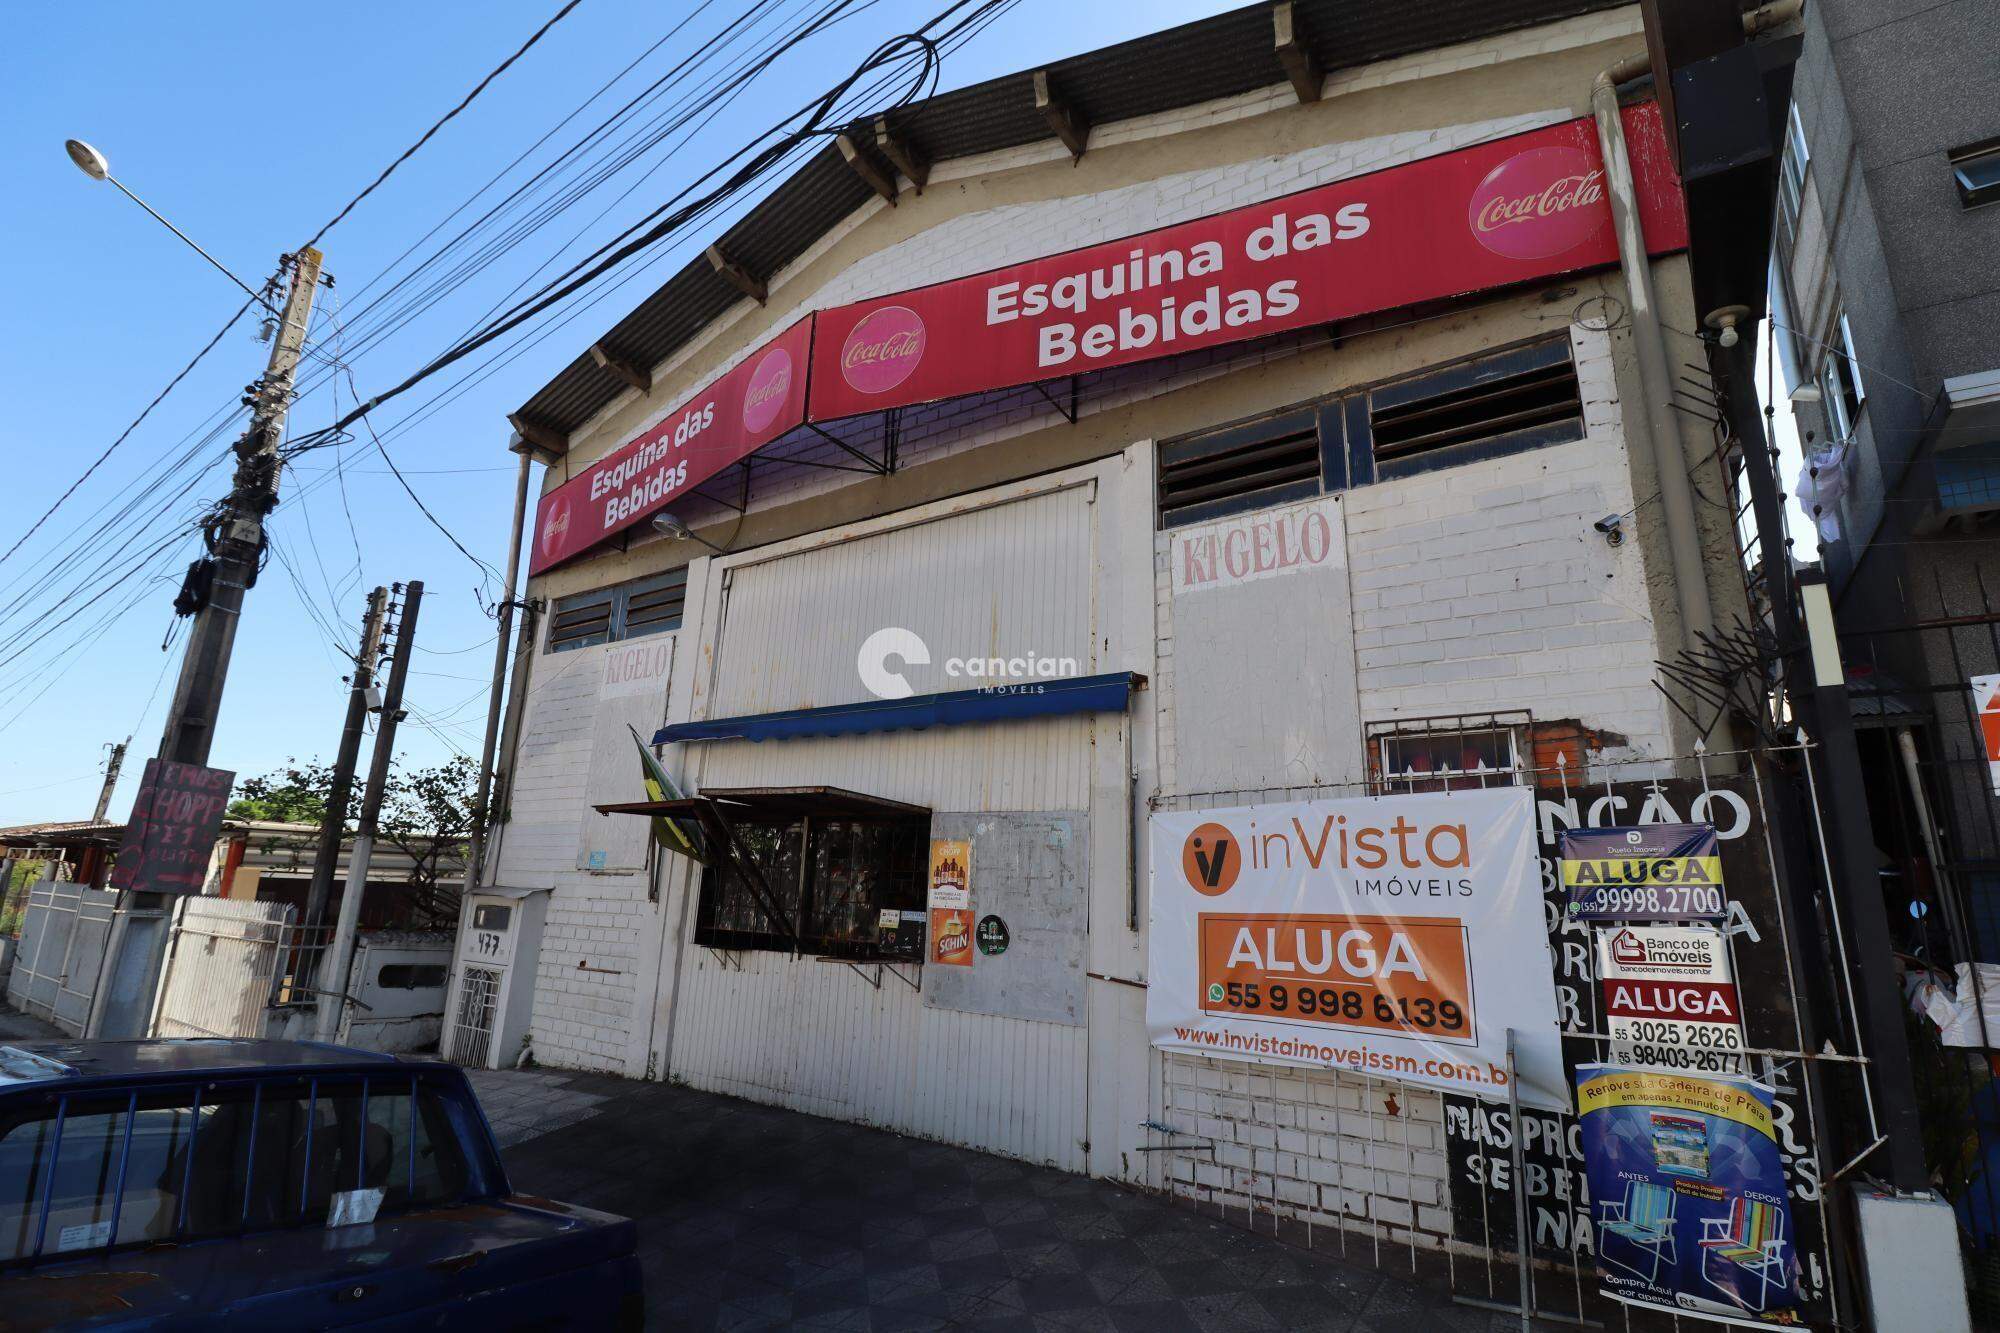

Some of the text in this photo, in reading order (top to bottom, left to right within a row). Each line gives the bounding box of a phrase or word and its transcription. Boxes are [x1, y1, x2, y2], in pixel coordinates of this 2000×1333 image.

[986, 202, 1371, 326] Esquina das
[1038, 279, 1300, 368] Bebidas
[590, 401, 715, 501] Esquina das
[604, 459, 688, 529] Bebidas
[134, 786, 223, 826] CHOPP
[1251, 815, 1471, 870] inVista
[1575, 859, 1711, 884] ALUGA
[1355, 876, 1474, 897] IMÓVEIS
[1595, 887, 1721, 913] 99998.2700
[478, 931, 500, 958] 477
[939, 933, 968, 954] SCHIN
[1226, 926, 1429, 982] ALUGA
[1646, 938, 1710, 950] Banco de
[1647, 949, 1712, 964] Imóveis
[1620, 965, 1712, 975] bancodeimoveis.com.br
[1226, 982, 1464, 1031] 55 9 998 6139
[1612, 985, 1733, 1017] ALUGA
[1615, 1020, 1738, 1050] 55 3025 2626
[1174, 1026, 1509, 1086] www.invistaimoveissm.com.b
[1618, 1051, 1631, 1066] 55
[1632, 1044, 1743, 1075] 98403-2677
[1586, 1078, 1766, 1122] Renove sua Cadeira de Praia
[1621, 1093, 1730, 1114] em apenas 2 minutos!
[1617, 1170, 1649, 1183] ANTES
[1744, 1189, 1782, 1205] DEPOIS
[1605, 1273, 1673, 1297] Compre Aqui
[1618, 1288, 1676, 1307] por apenas
[1679, 1296, 1698, 1308] R$
